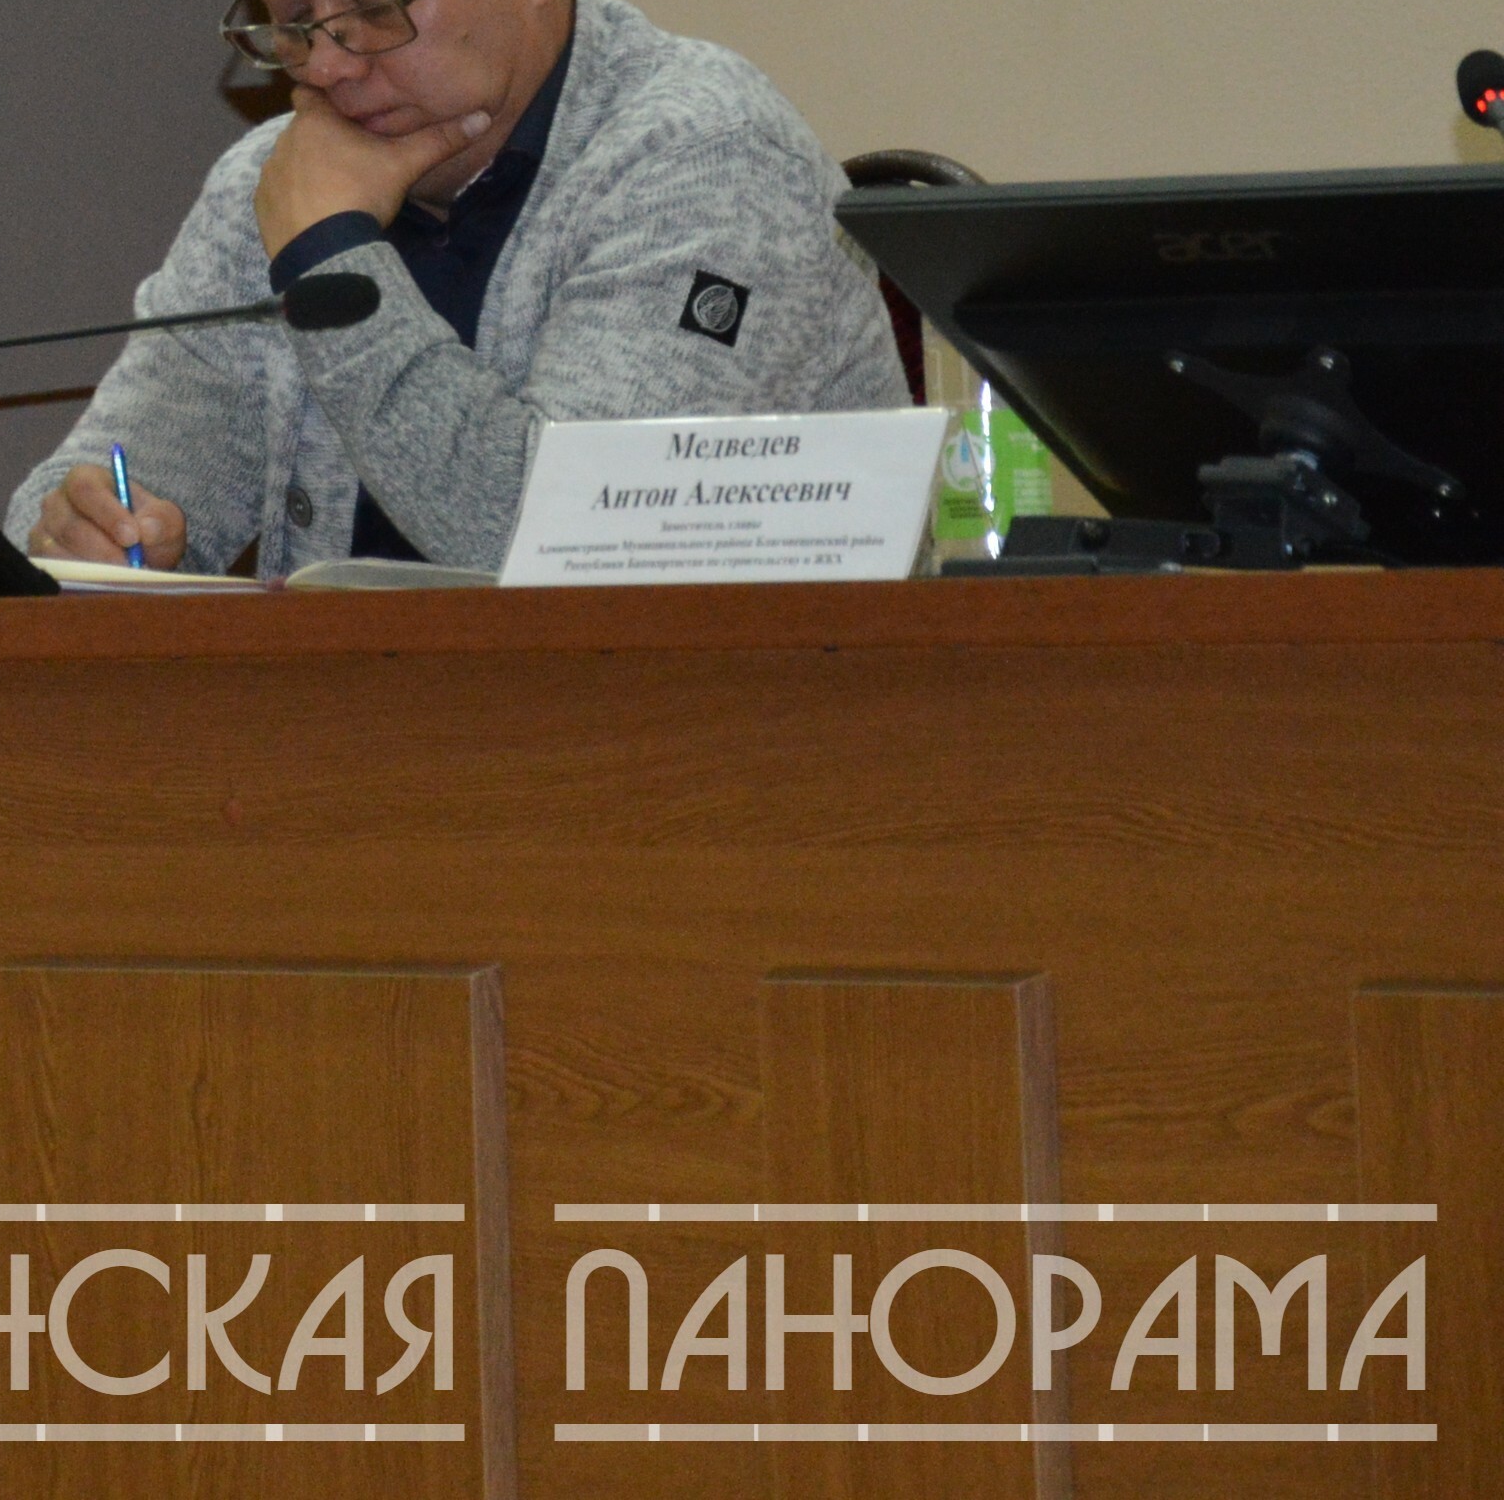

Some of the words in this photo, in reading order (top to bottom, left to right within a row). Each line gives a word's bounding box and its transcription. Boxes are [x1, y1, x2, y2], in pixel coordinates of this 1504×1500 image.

[1152, 230, 1280, 262] acer
[666, 432, 801, 462] Медведев
[591, 483, 678, 511] Антон
[683, 477, 853, 507] Алексеевич
